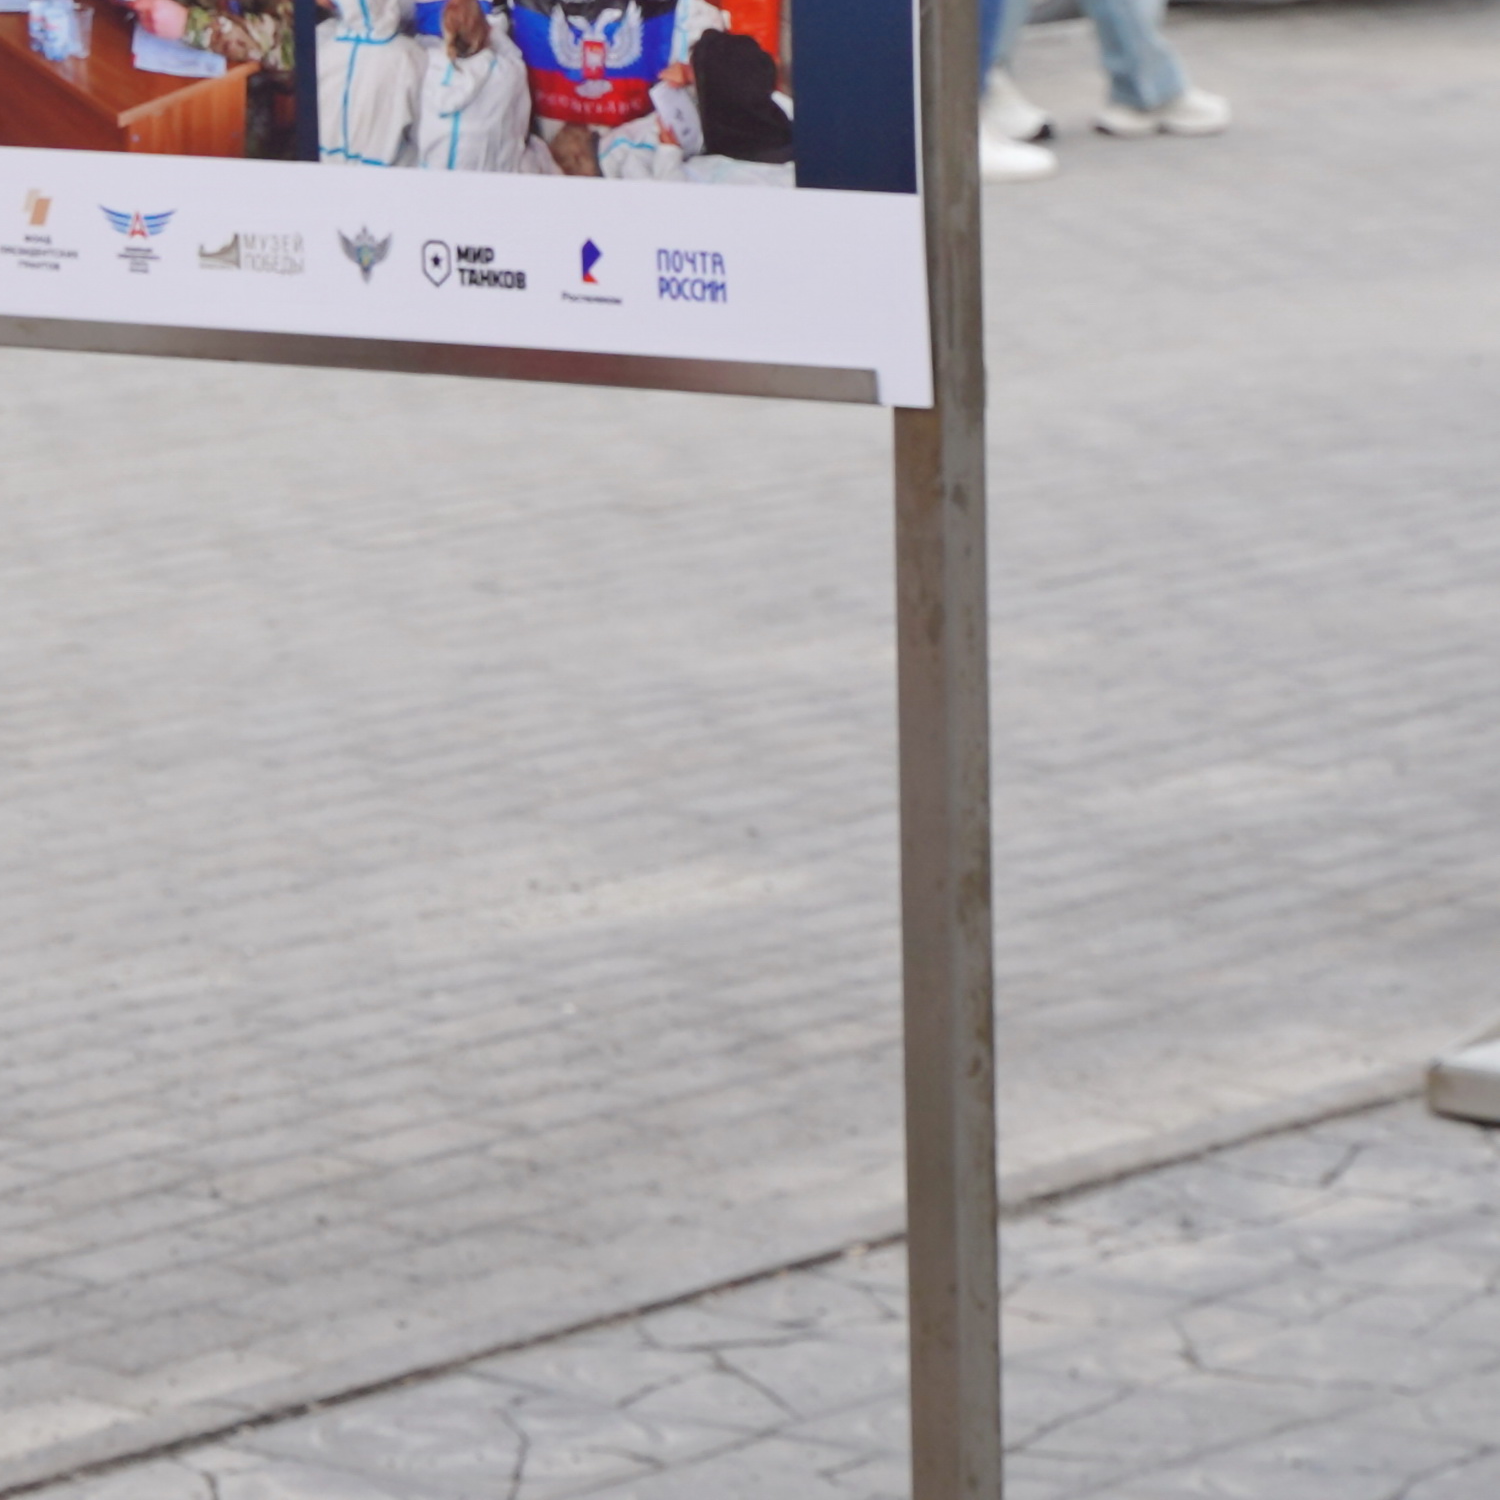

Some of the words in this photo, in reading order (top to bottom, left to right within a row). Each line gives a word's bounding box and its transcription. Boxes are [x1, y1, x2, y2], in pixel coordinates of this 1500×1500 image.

[243, 231, 304, 253] МУЗЕЙ
[457, 245, 495, 264] МИР
[657, 248, 726, 275] ПОЧТА
[458, 268, 526, 290] ТАНКОВ
[658, 276, 727, 303] РОССИИ
